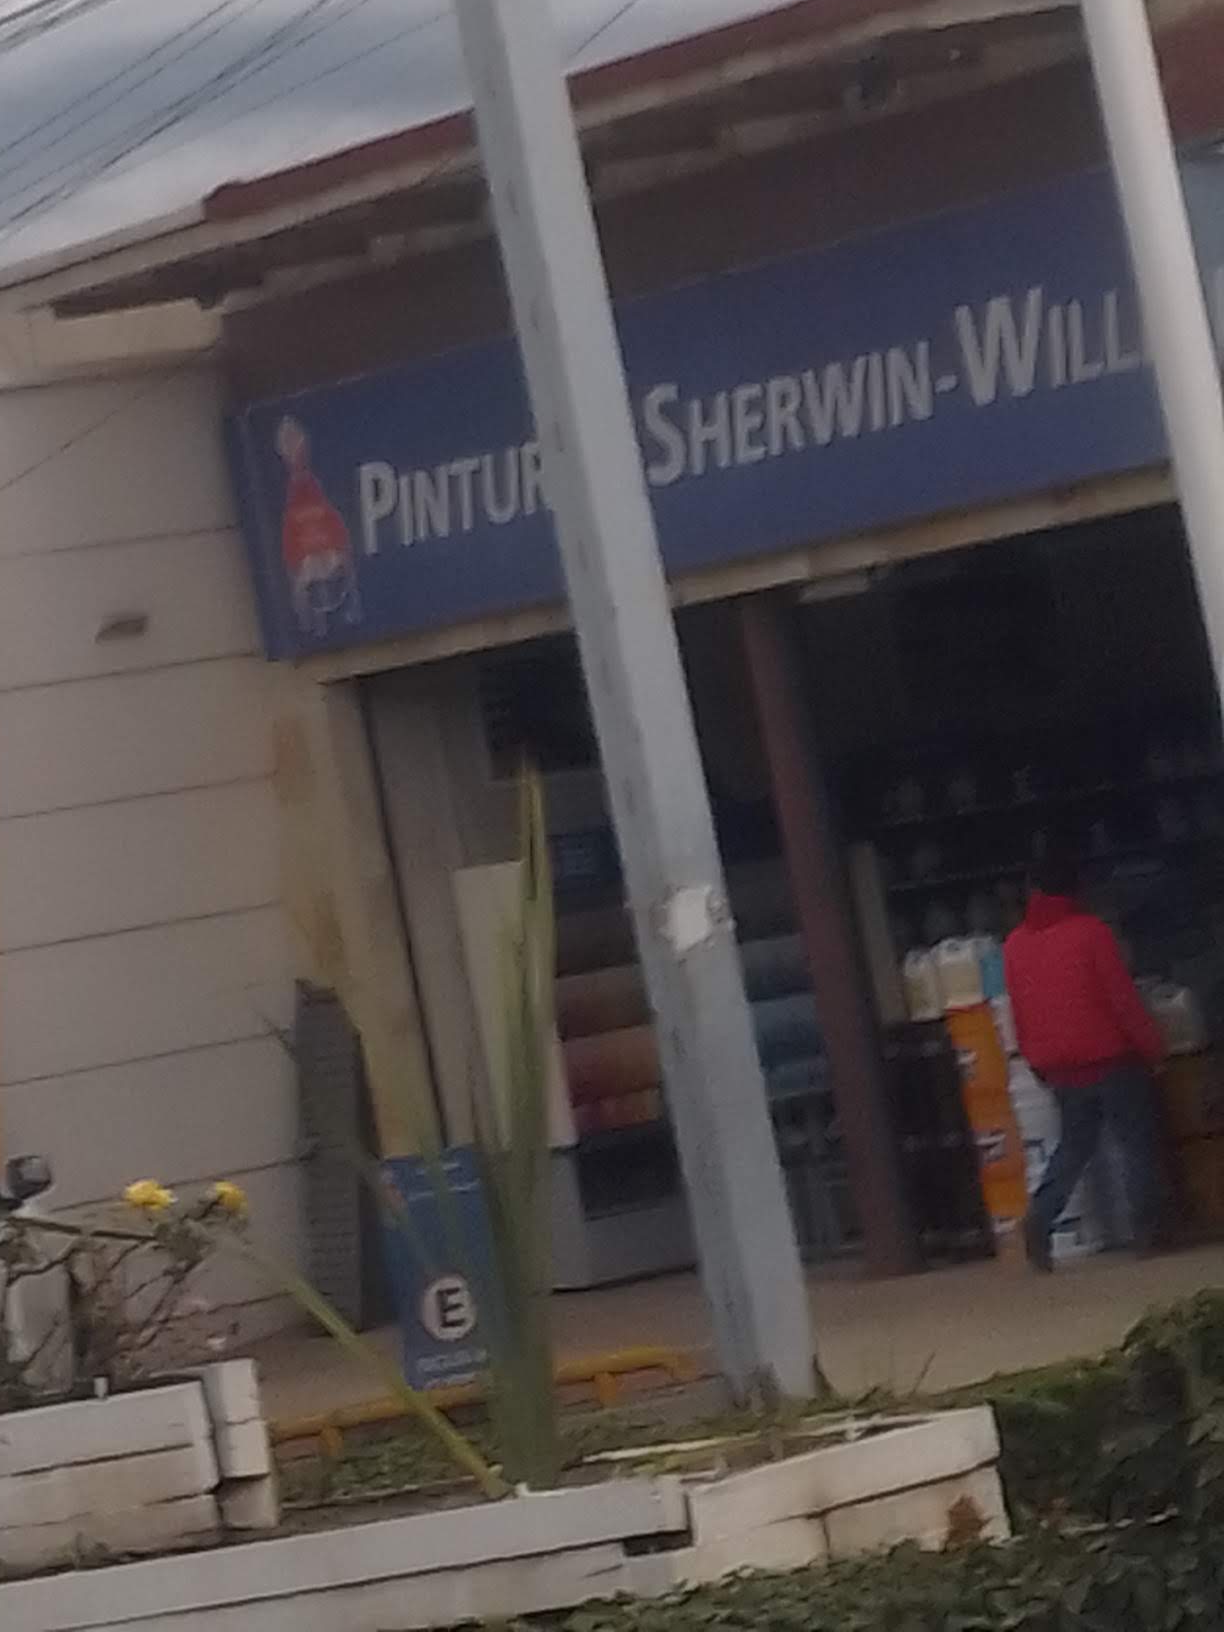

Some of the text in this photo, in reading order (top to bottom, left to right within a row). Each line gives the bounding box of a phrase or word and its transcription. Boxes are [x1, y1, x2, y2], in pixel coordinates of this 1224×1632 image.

[358, 286, 1142, 555] PINTUR SHERWIN-WILL
[436, 1286, 465, 1328] E
